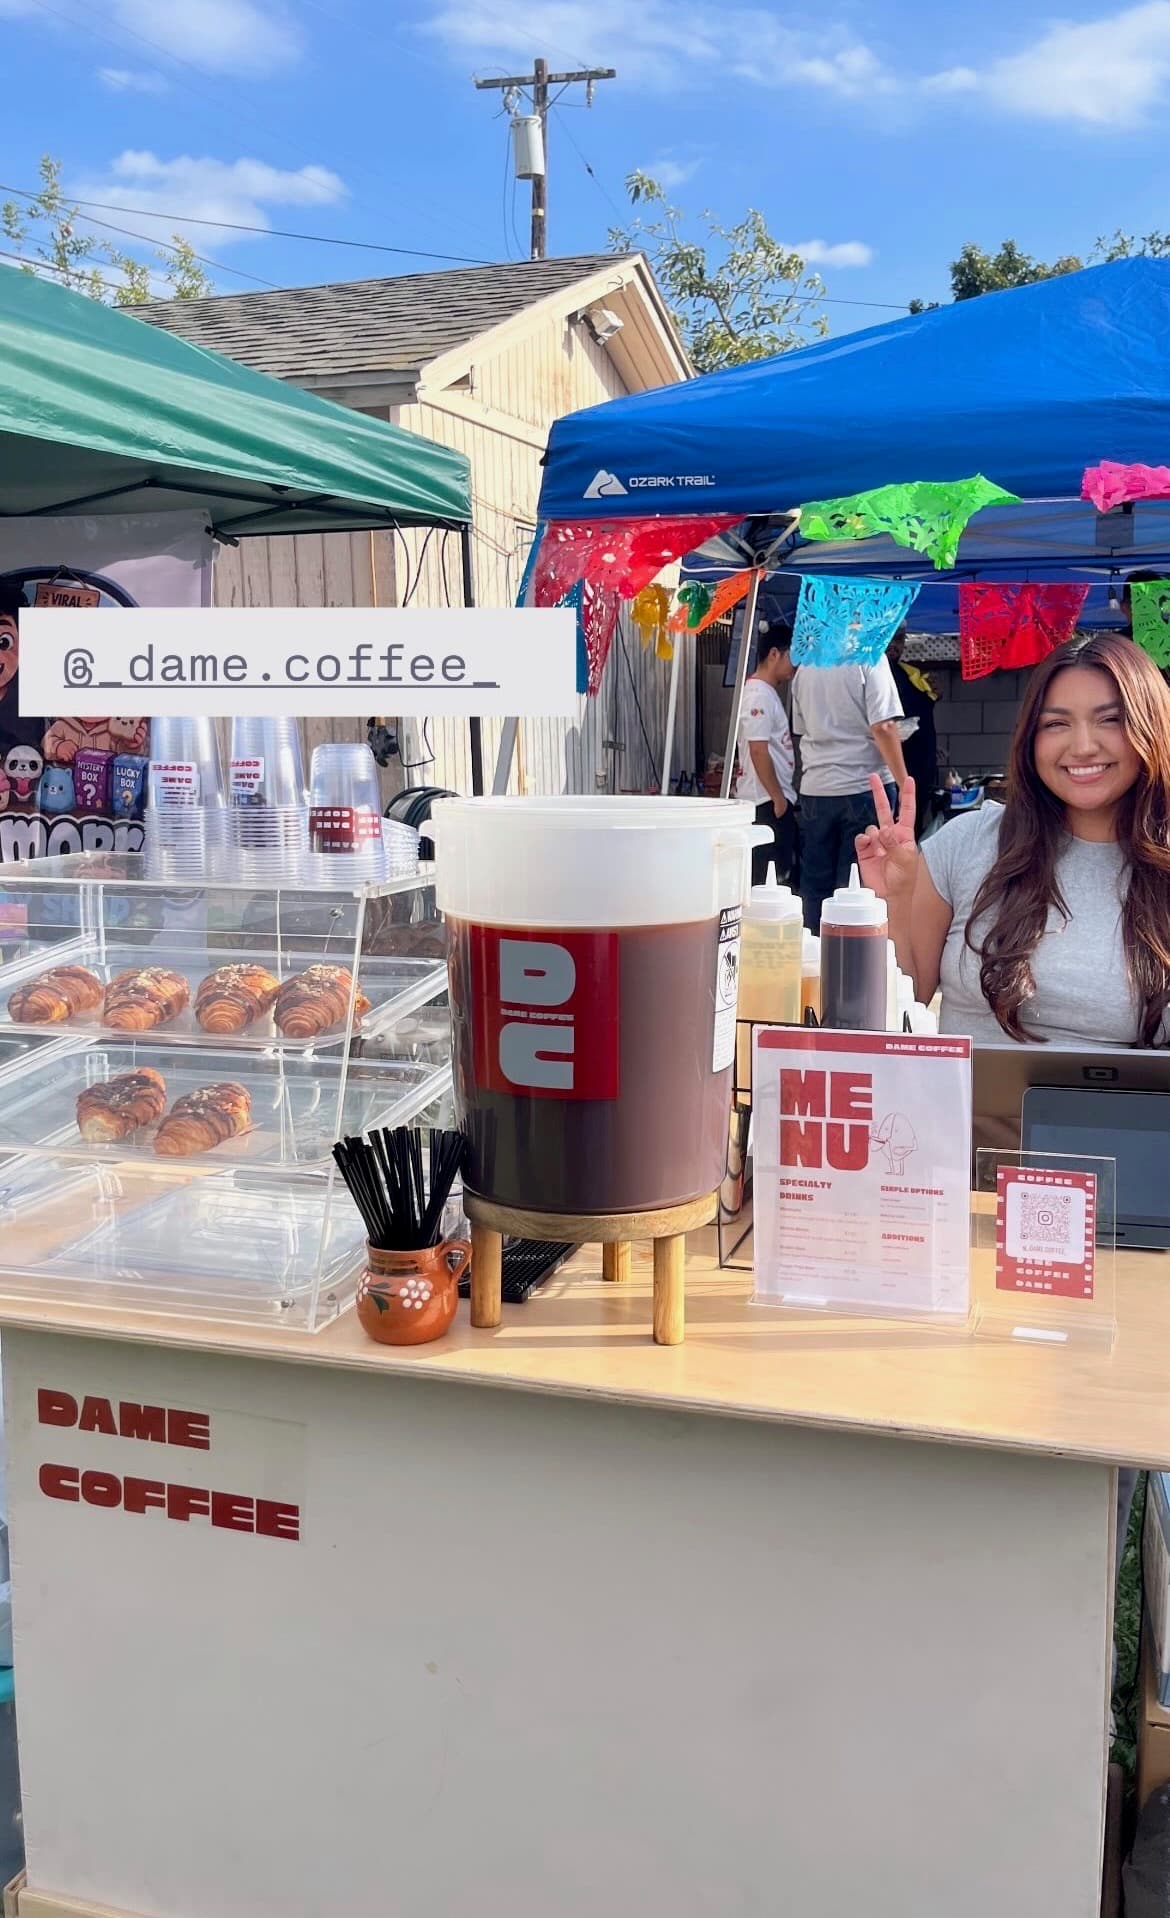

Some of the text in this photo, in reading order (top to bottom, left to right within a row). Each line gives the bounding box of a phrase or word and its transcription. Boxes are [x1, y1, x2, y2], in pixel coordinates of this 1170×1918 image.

[51, 592, 81, 608] VIRAL
[77, 760, 105, 773] MYSTERY
[81, 771, 98, 783] BOX
[116, 767, 141, 779] LUCKY
[120, 778, 136, 789] BOX
[885, 1043, 964, 1054] DAME COFFEE
[780, 1068, 873, 1121] ME
[779, 1119, 870, 1171] NU
[779, 1178, 833, 1190] SPECIALTY
[1017, 1174, 1073, 1186] COFFEE
[779, 1191, 815, 1202] DRINKS
[910, 1187, 945, 1196] OPTIONS
[881, 1232, 926, 1243] ADDITIONS
[1016, 1267, 1070, 1279] COFFEE
[1015, 1279, 1053, 1290] DAME
[37, 1387, 211, 1450] DAME
[38, 1462, 300, 1542] COFFEE
